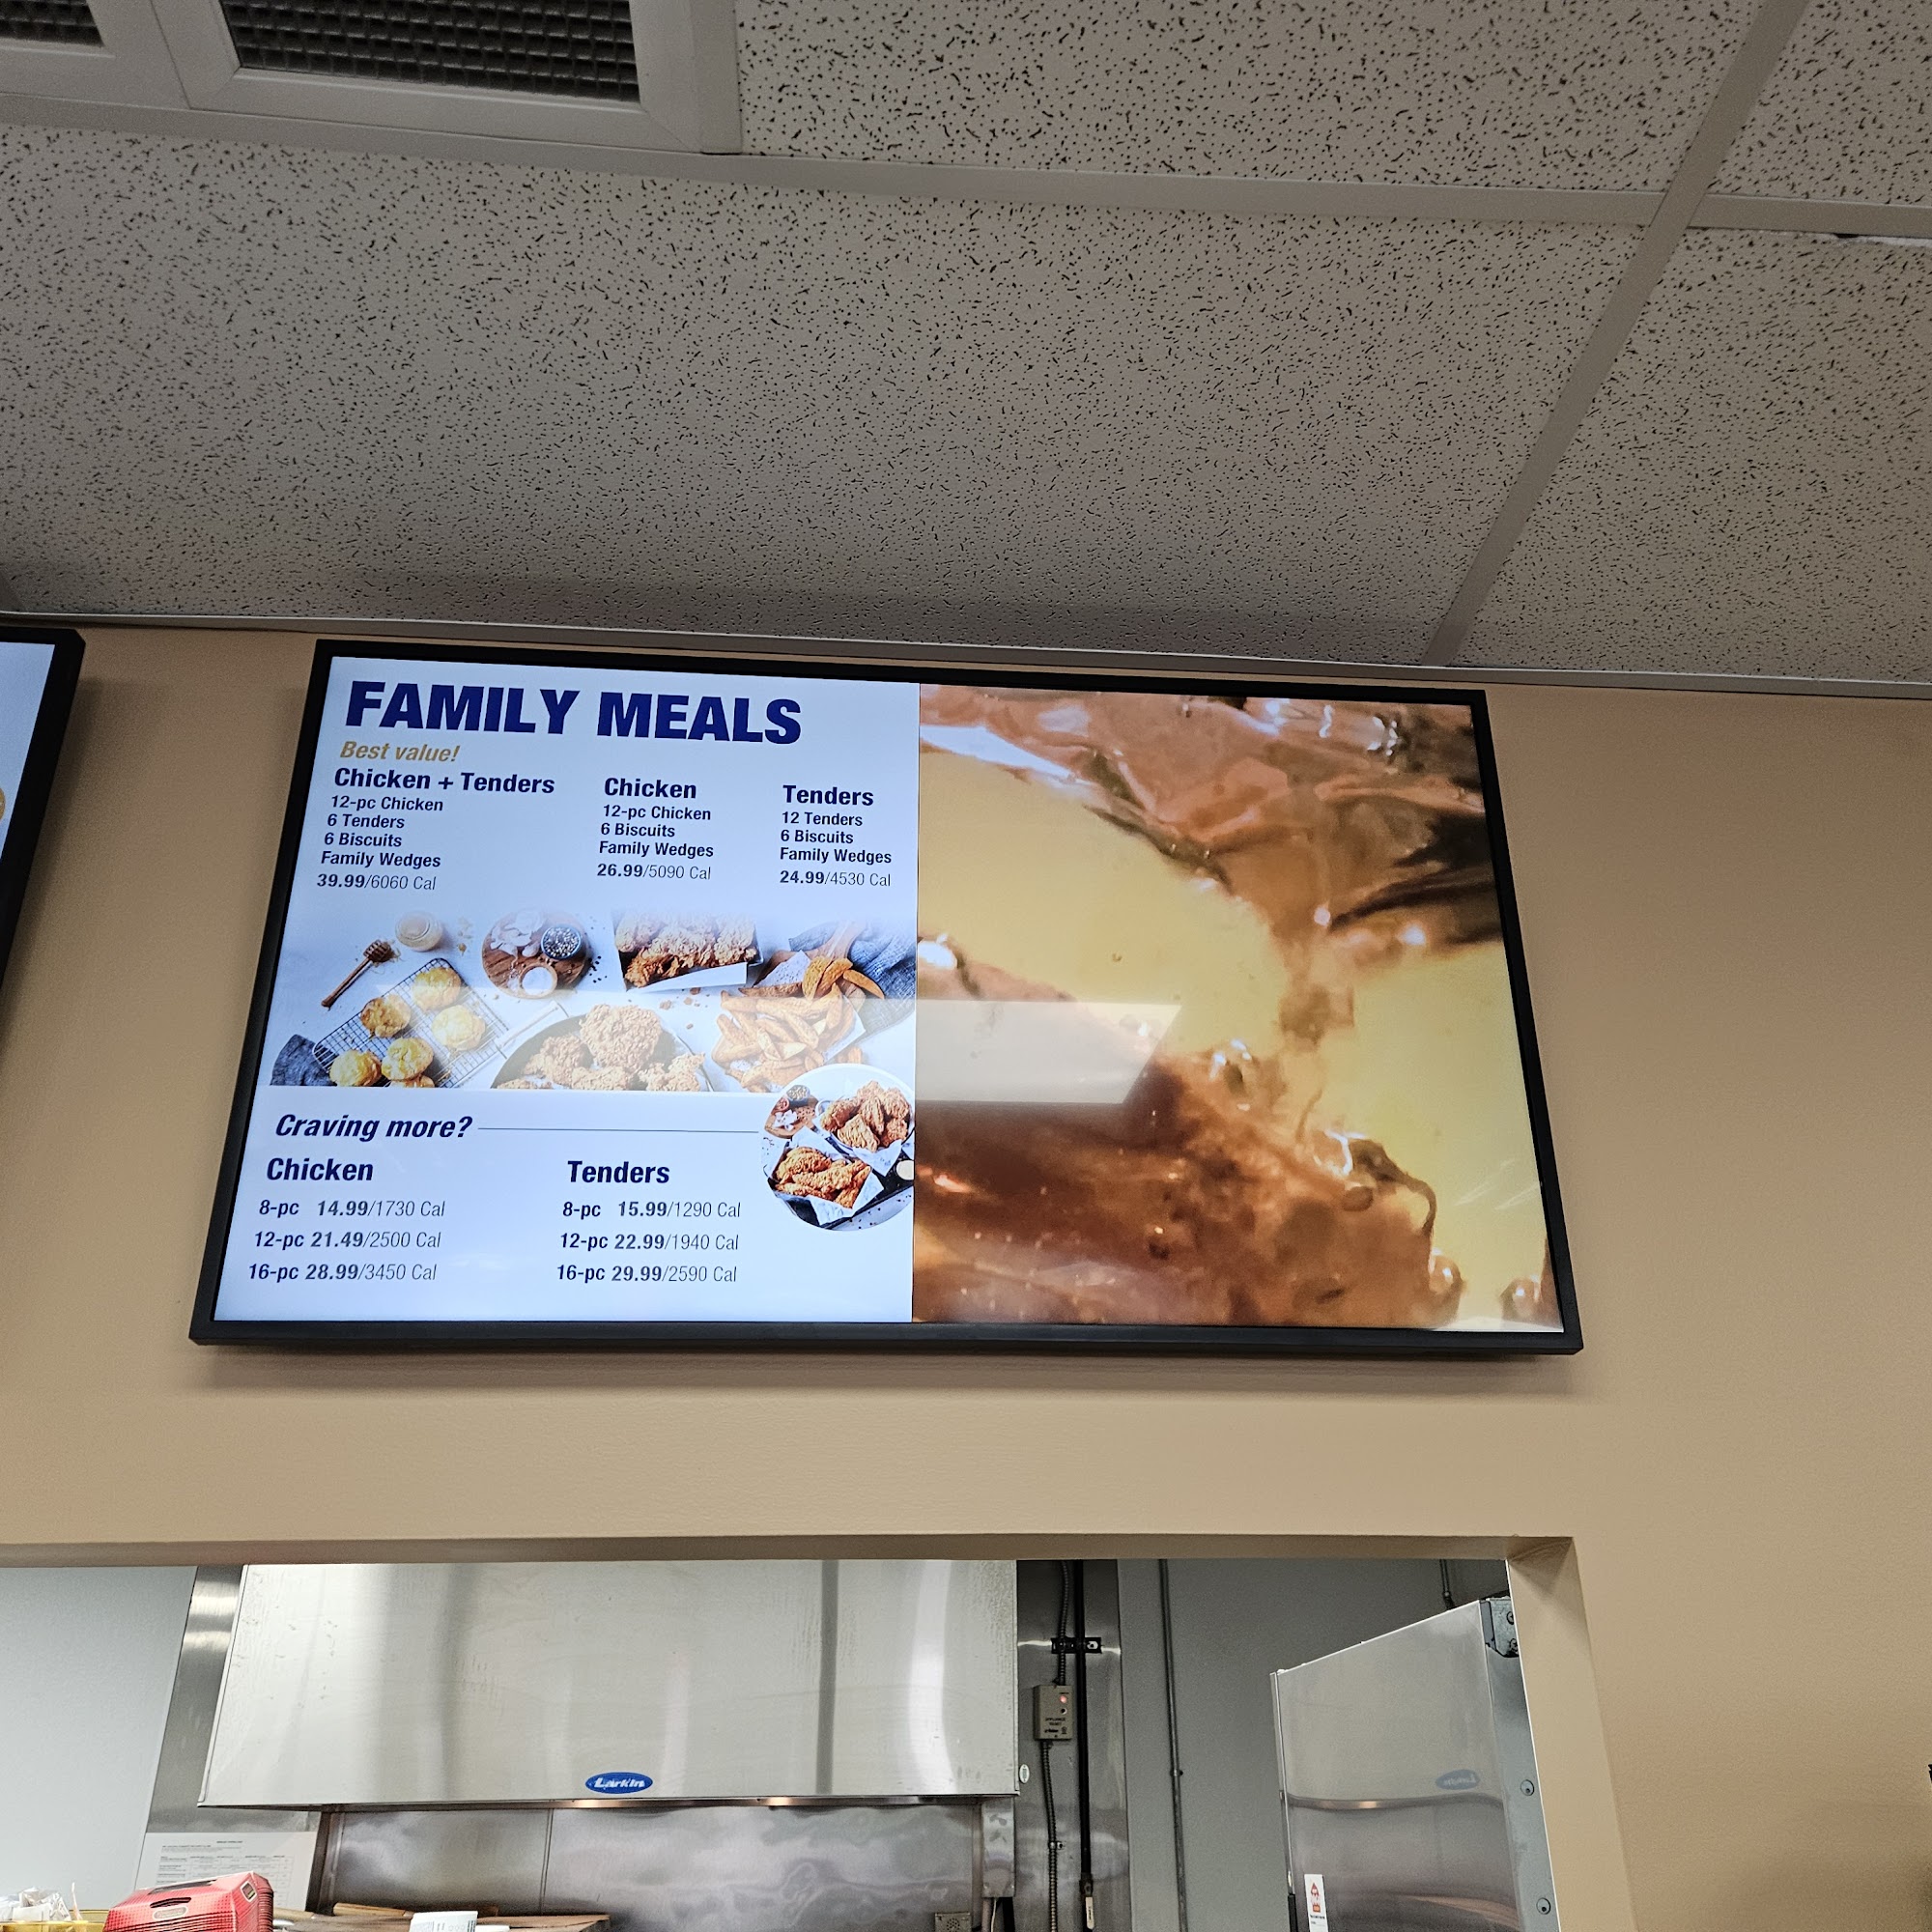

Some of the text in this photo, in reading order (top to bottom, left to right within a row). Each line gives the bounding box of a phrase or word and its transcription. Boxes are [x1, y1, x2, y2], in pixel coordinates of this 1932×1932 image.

[346, 681, 801, 744] FAMILY MEALS
[340, 741, 460, 761] Best value!
[335, 768, 430, 789] Chicken
[461, 772, 554, 793] Tenders
[605, 778, 696, 799] Chicken
[331, 795, 442, 811] 12-pc Chicken
[782, 785, 873, 806] Tenders
[327, 813, 405, 828] 6 Tenders
[603, 805, 711, 821] 12-pc Chicken
[782, 811, 863, 826] 12 Tenders
[325, 832, 402, 847] 6 Biscuits
[601, 823, 675, 838] 6 Biscuits
[781, 830, 853, 843] 6 Biscuits
[600, 840, 713, 859] Family Wedges
[781, 847, 892, 866] Family Wedges
[321, 851, 440, 869] Family Wedges
[597, 864, 710, 880] 26.99/5090 Cal
[780, 870, 890, 886] 24.99/4530 Cal
[317, 874, 436, 890] 39.99/6060 Cal
[275, 1114, 472, 1142] Craving more?
[267, 1157, 373, 1180] Chicken
[568, 1160, 669, 1183] Tenders
[259, 1200, 445, 1218] 8-pc 14.99/1730 Cal
[563, 1201, 740, 1220] 8-pc 15.99/1290 Cal
[255, 1232, 440, 1250] 12-pc 21.49/2500 Cal
[561, 1233, 738, 1252] 12-pc 22.99/1940 Cal
[249, 1264, 437, 1283] 16-pc 28.99/3450 Cal
[557, 1264, 736, 1284] 16-pc 29.99/2590 Cal
[593, 1777, 645, 1788] Larkin
